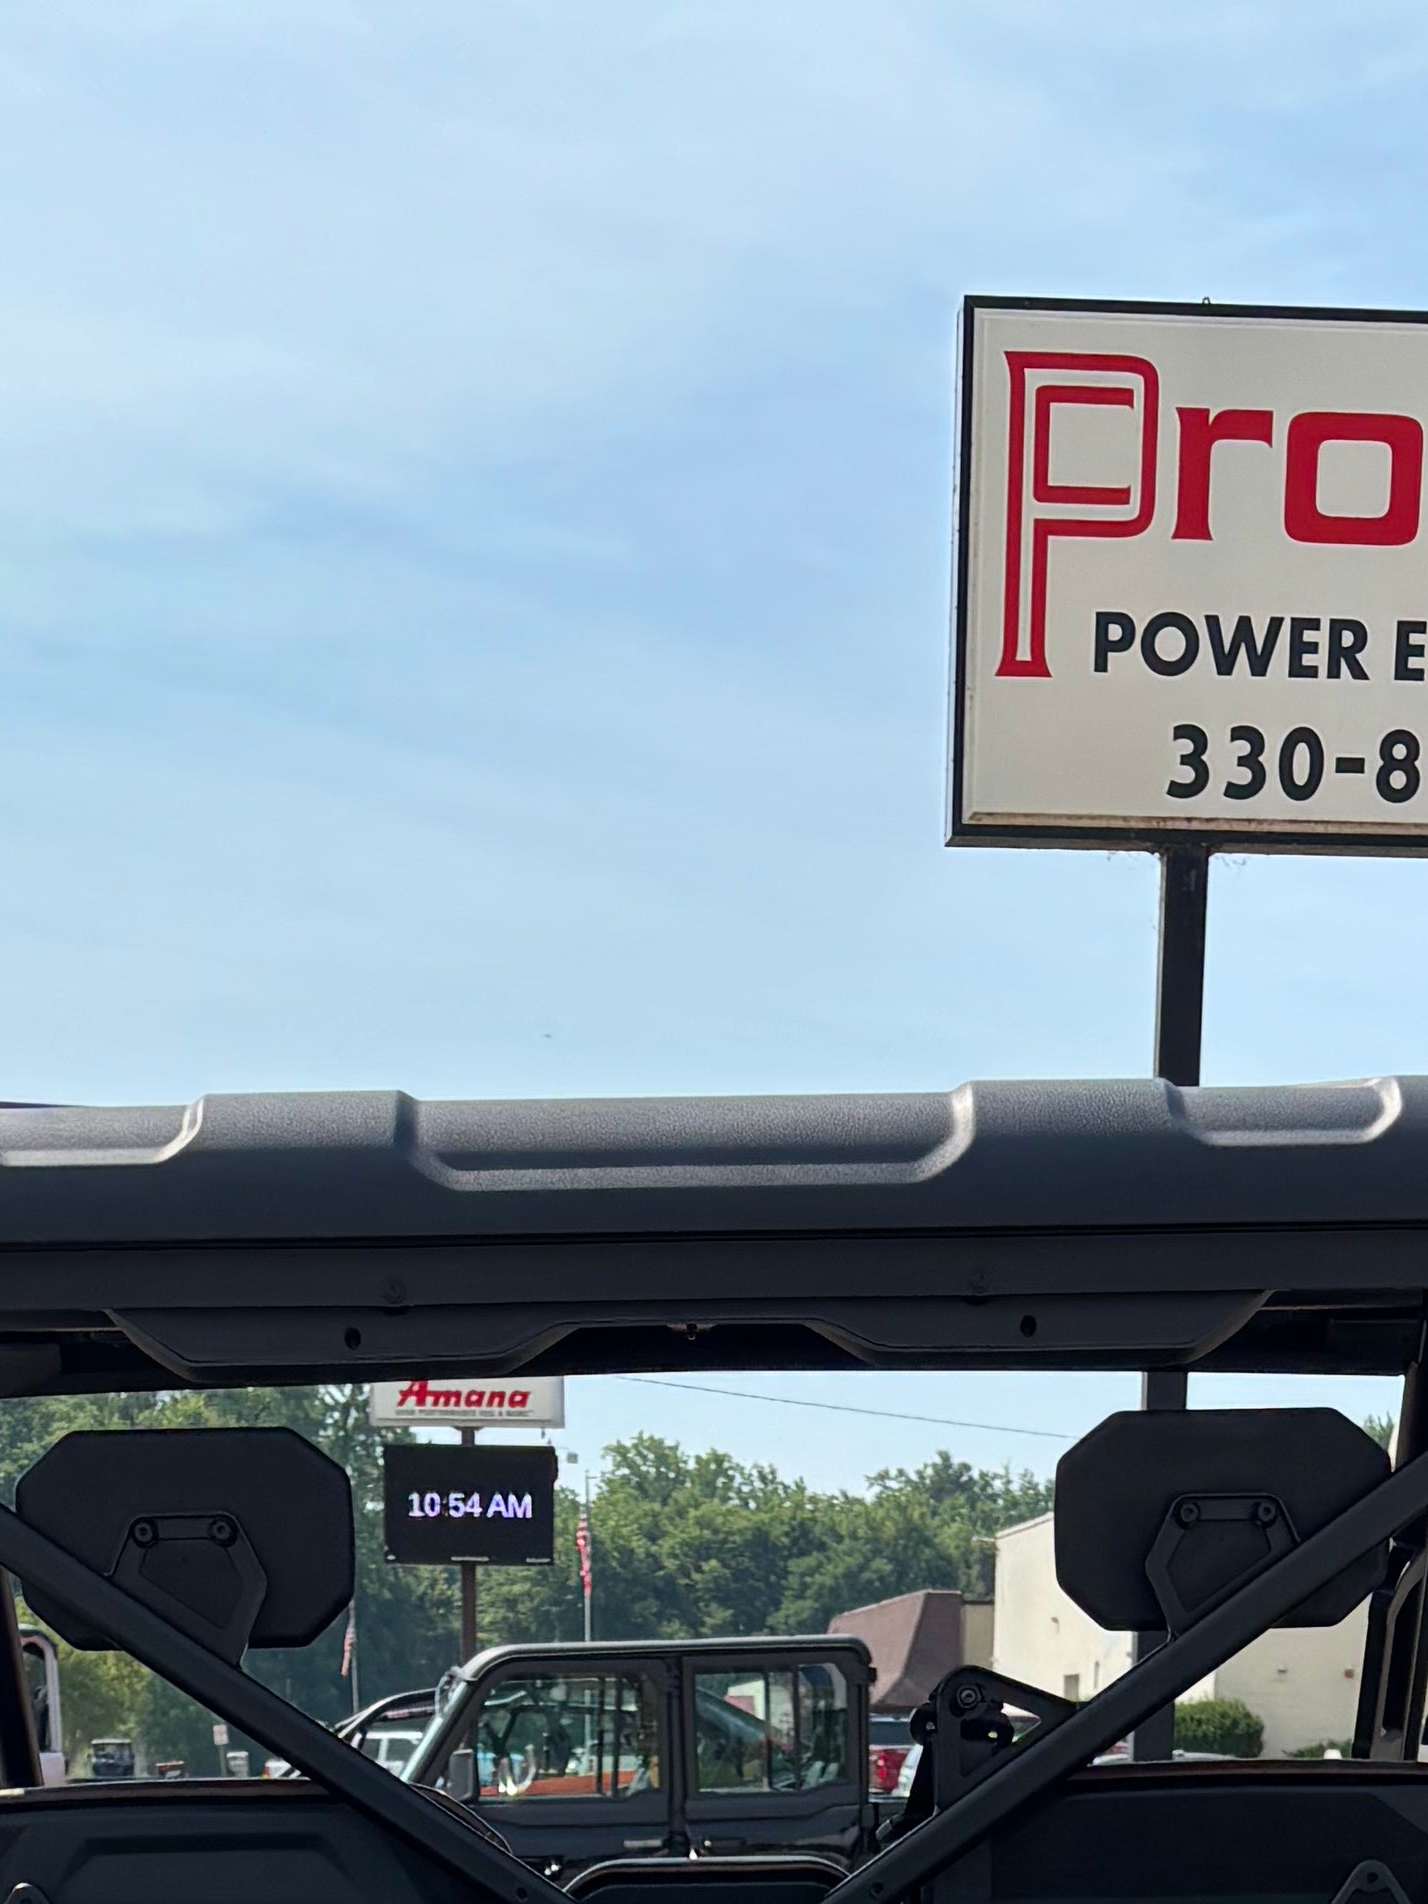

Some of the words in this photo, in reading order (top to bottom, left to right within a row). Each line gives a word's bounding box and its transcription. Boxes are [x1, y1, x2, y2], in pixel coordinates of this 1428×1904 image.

[1093, 610, 1368, 681] POWER
[396, 1379, 532, 1409] Amana
[408, 1492, 483, 1518] 10:54
[486, 1492, 533, 1519] AM
